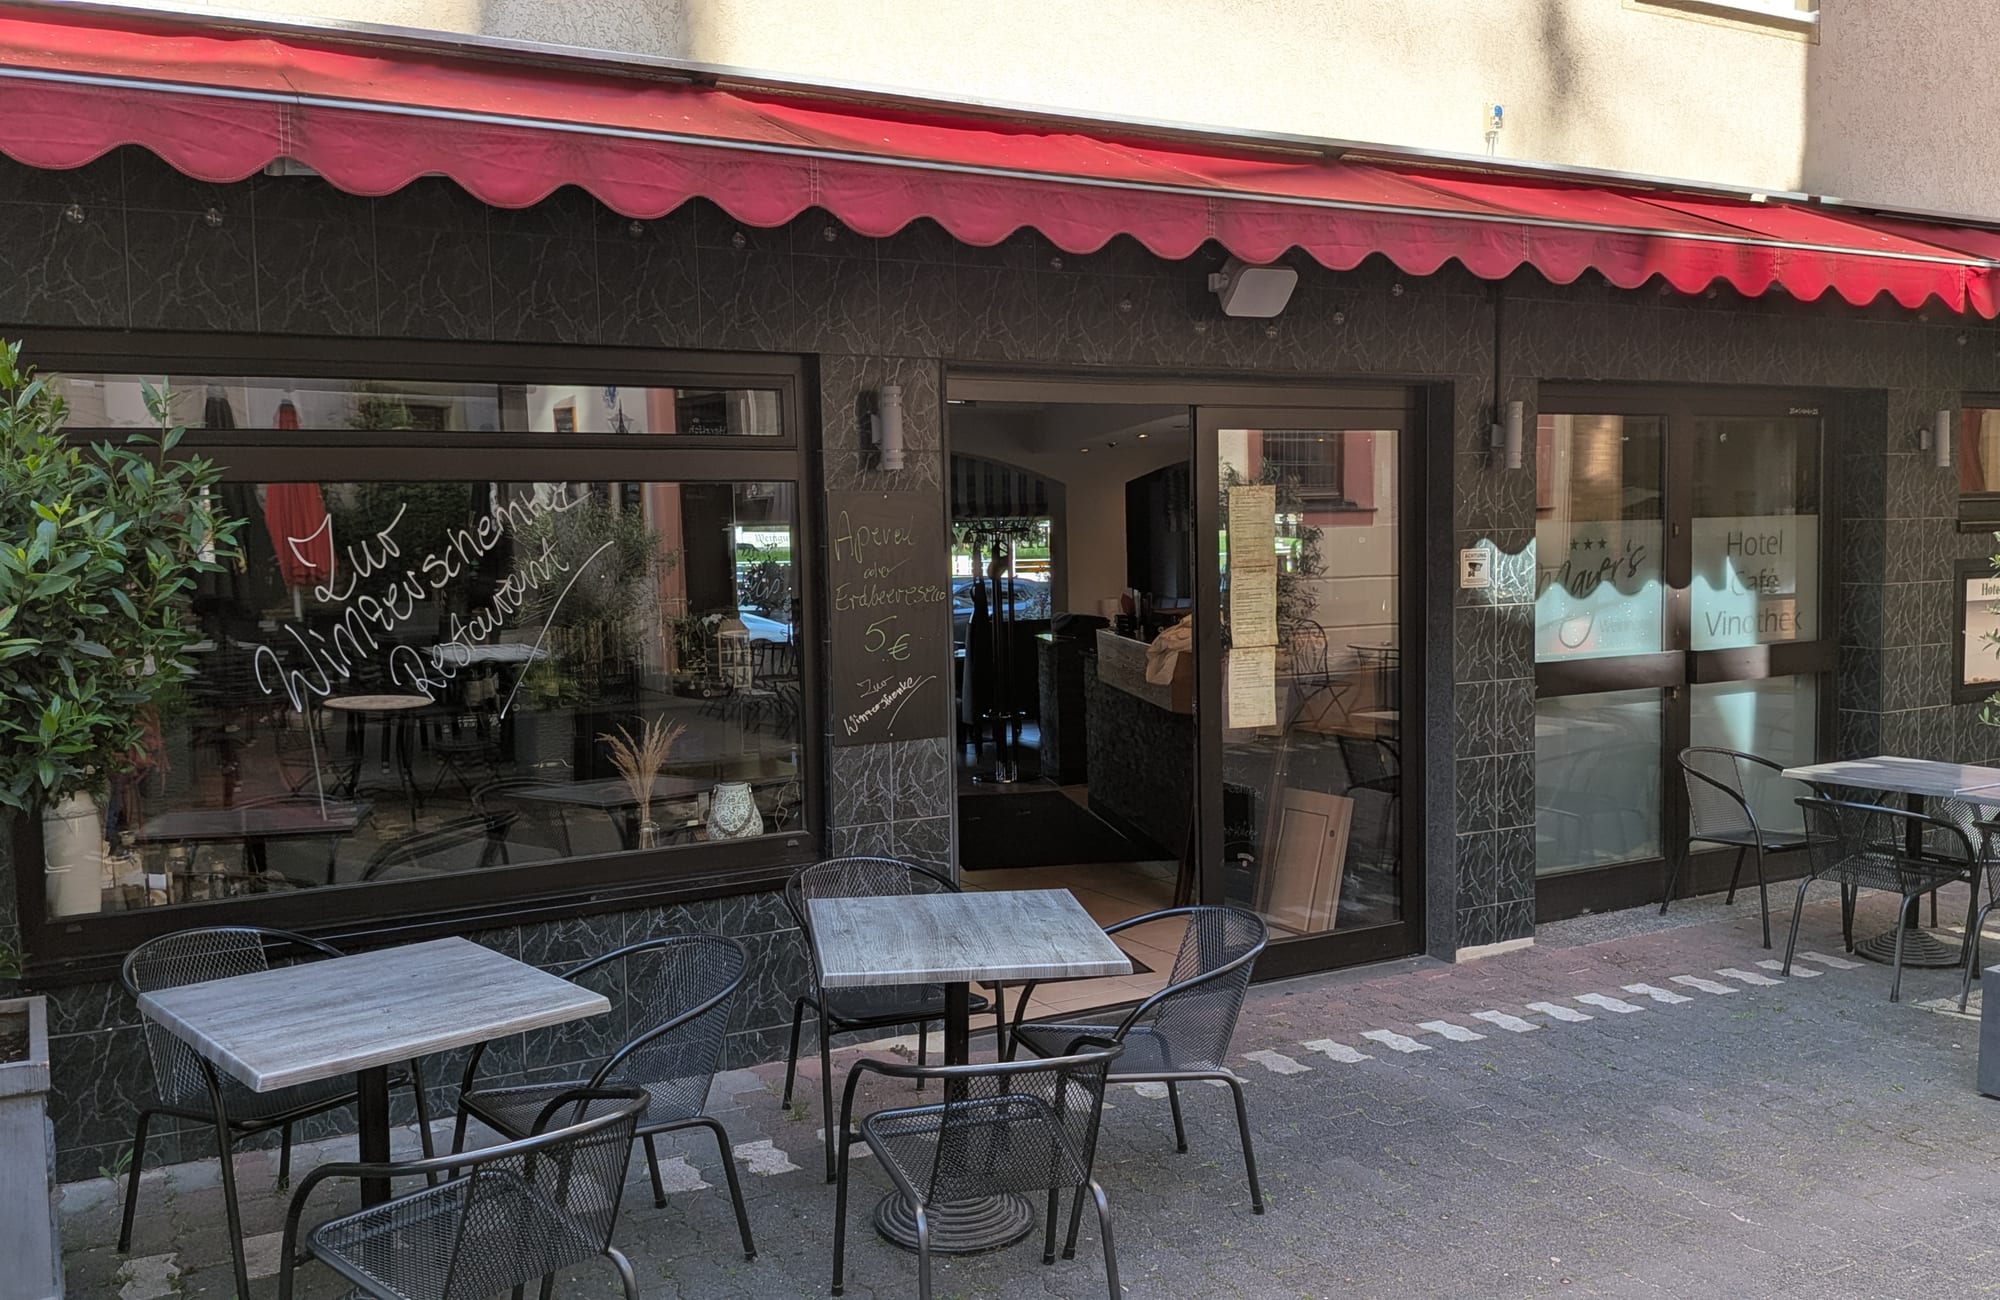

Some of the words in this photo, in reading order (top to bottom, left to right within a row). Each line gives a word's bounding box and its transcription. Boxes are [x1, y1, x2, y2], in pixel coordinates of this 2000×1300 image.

[288, 503, 407, 602] Zur
[834, 510, 916, 564] Aperol
[1726, 528, 1783, 557] Hotel
[1731, 567, 1781, 596] Café
[389, 537, 570, 701] Restaurant
[864, 615, 897, 652] 5
[888, 633, 911, 661] €
[1704, 608, 1803, 637] Vinothek
